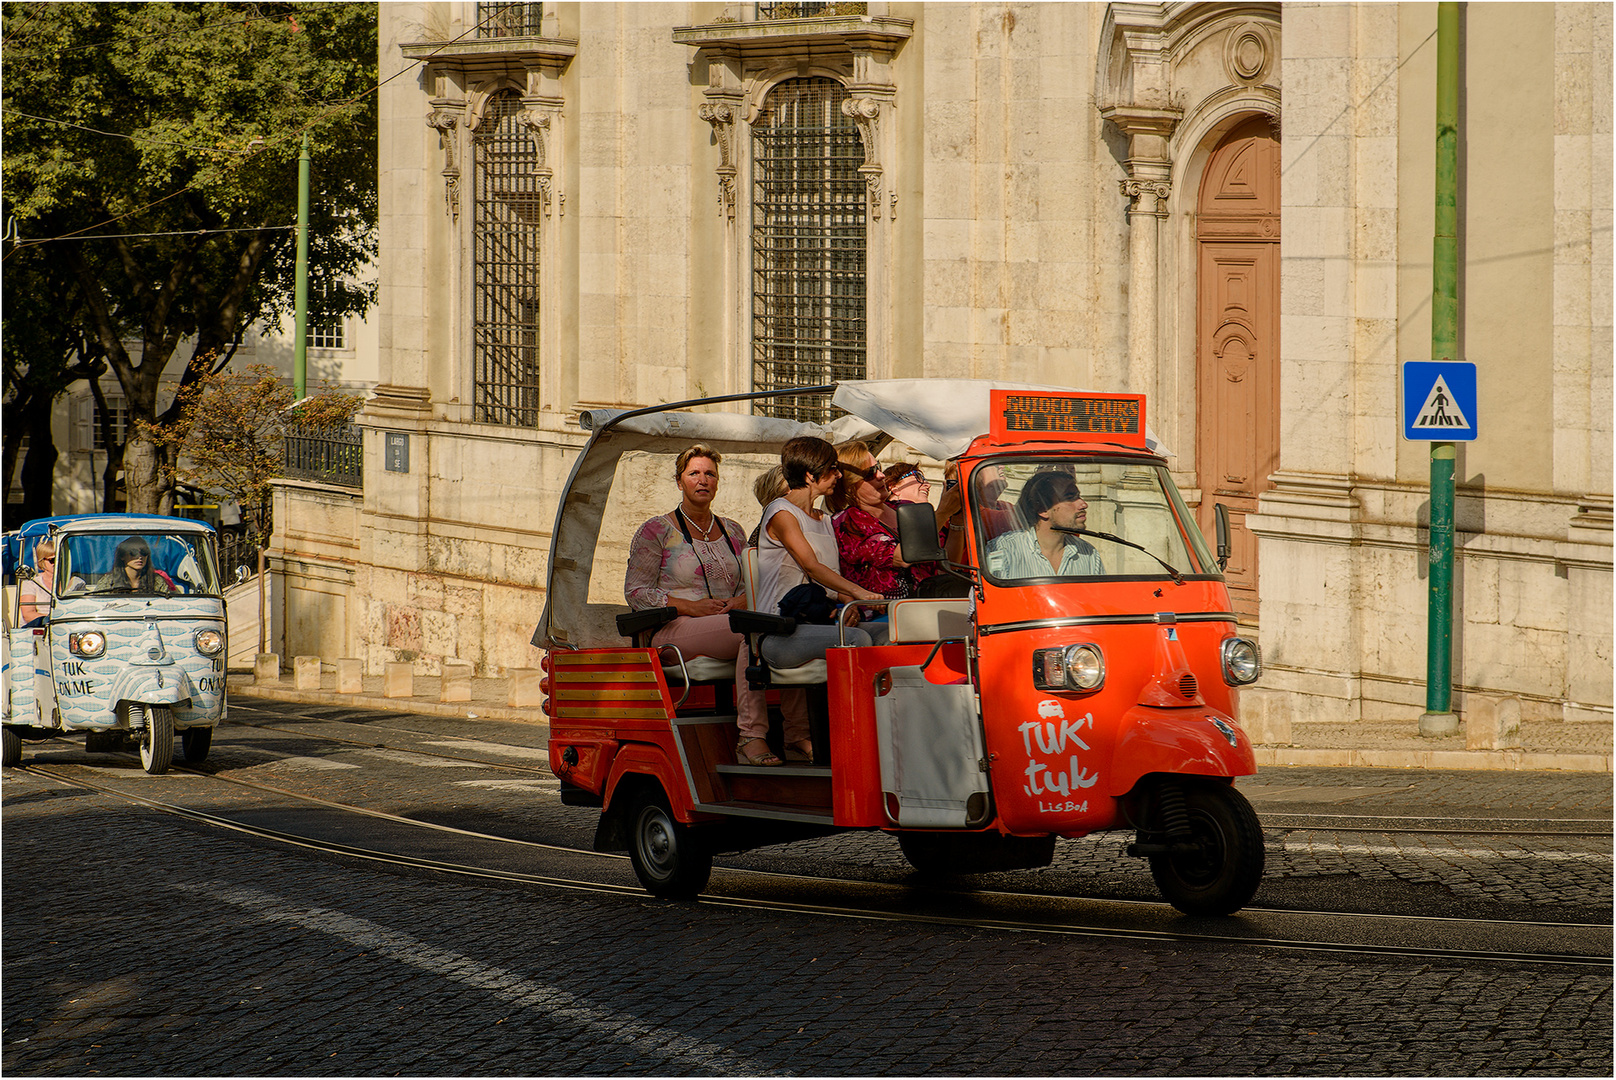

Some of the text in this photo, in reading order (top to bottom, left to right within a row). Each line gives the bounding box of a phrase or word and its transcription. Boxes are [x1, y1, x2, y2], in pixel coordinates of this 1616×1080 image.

[1006, 396, 1138, 417] GUIDED TOURS
[1013, 413, 1130, 433] IN THE CITY
[62, 661, 87, 676] TUK
[59, 679, 96, 696] ON ME
